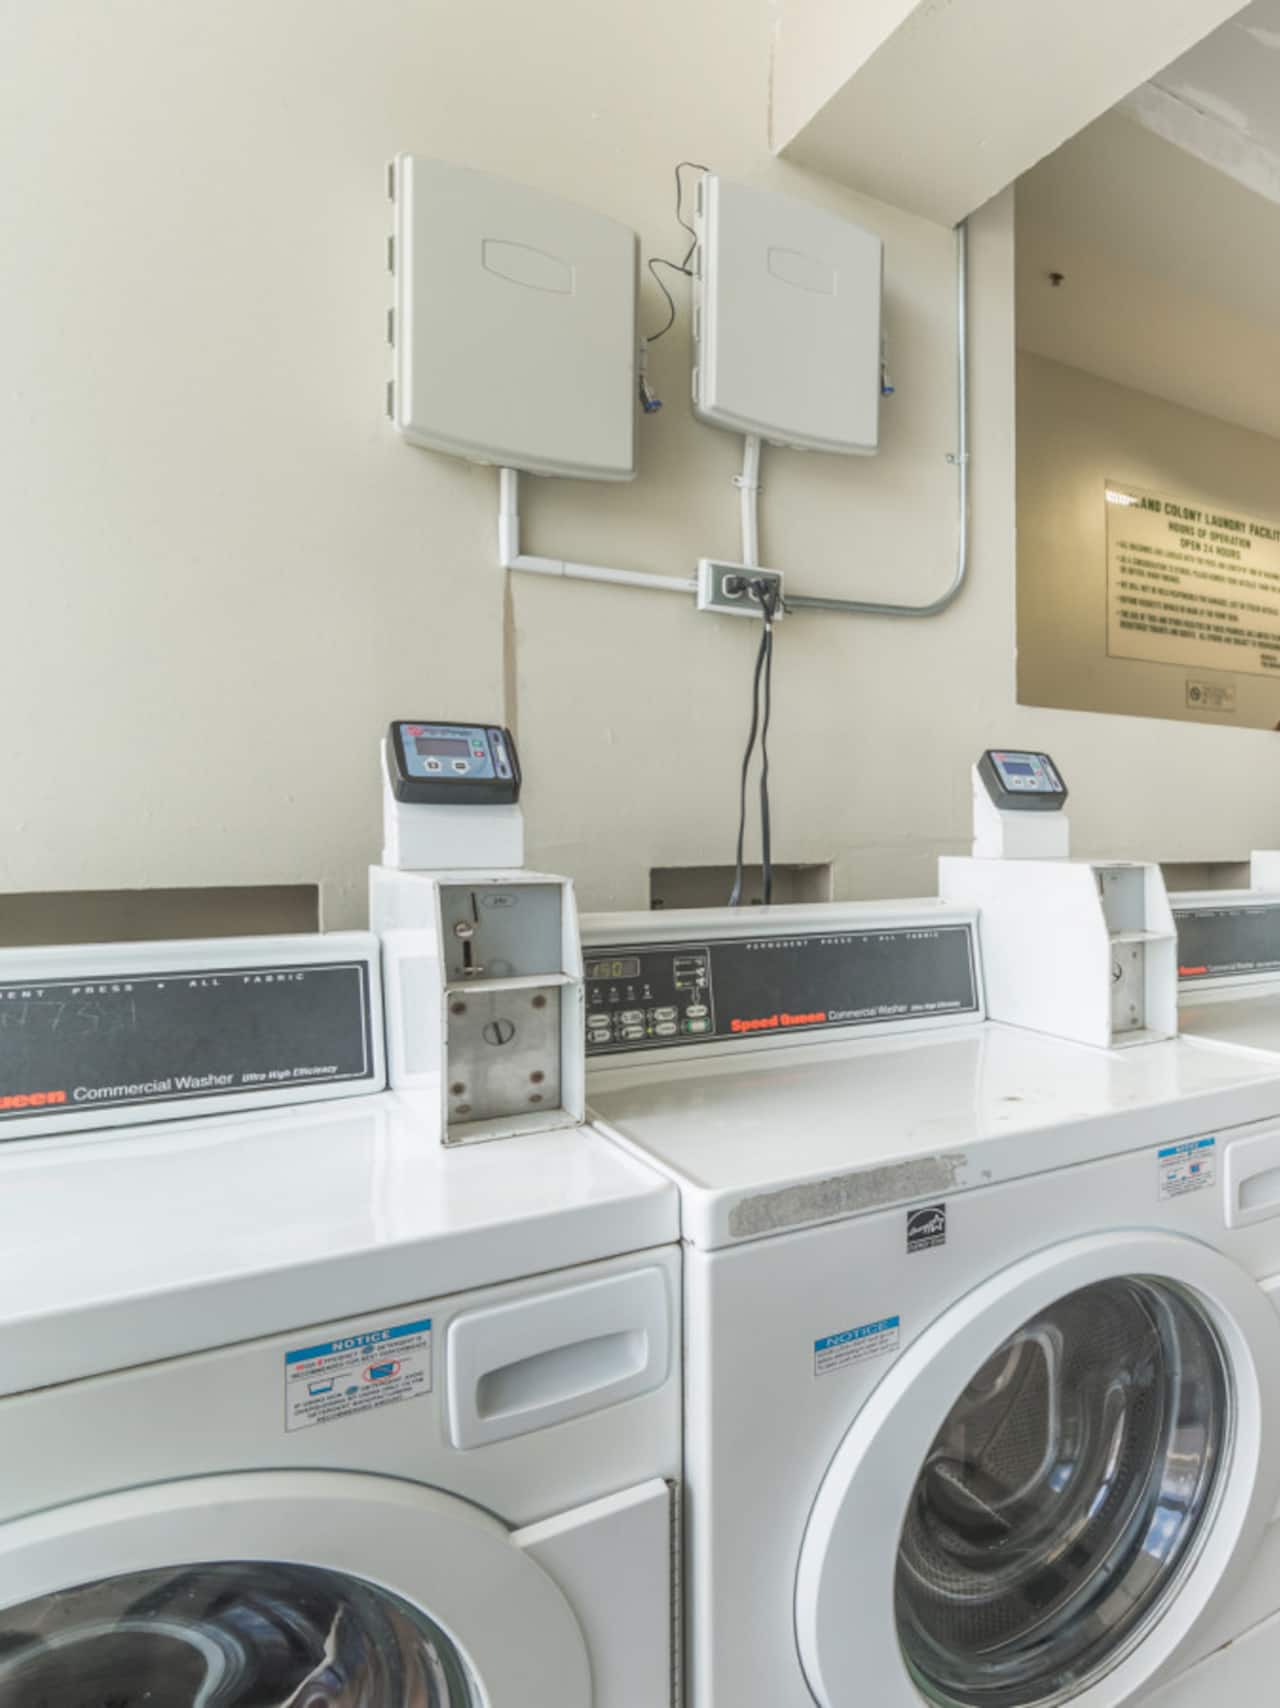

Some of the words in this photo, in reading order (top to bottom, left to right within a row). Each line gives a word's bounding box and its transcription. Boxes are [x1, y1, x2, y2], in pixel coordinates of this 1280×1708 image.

[1164, 502, 1202, 522] COLONY
[1204, 512, 1246, 534] LAUNDRY
[1168, 521, 1195, 537] HOURS
[1197, 527, 1206, 538] OF
[1209, 530, 1251, 549] OPERATION
[1180, 538, 1201, 551] OPEN
[1203, 543, 1214, 553] 24
[1216, 546, 1241, 560] HOURS
[0, 990, 45, 1000] ENT
[72, 983, 133, 994] PRESS
[189, 978, 220, 988] ALL
[243, 973, 305, 984] FABRIC
[731, 1014, 779, 1032] Speed
[781, 1011, 826, 1026] Queen
[828, 1007, 877, 1021] Commercial
[878, 1003, 908, 1015] Washer
[73, 1078, 172, 1101] Commercial
[174, 1073, 234, 1089] Washer
[241, 1073, 266, 1083] Ultra
[268, 1069, 291, 1081] High
[292, 1065, 338, 1077] Efficiency
[331, 1330, 391, 1351] NOTICE
[826, 1320, 889, 1347] NOTICE
